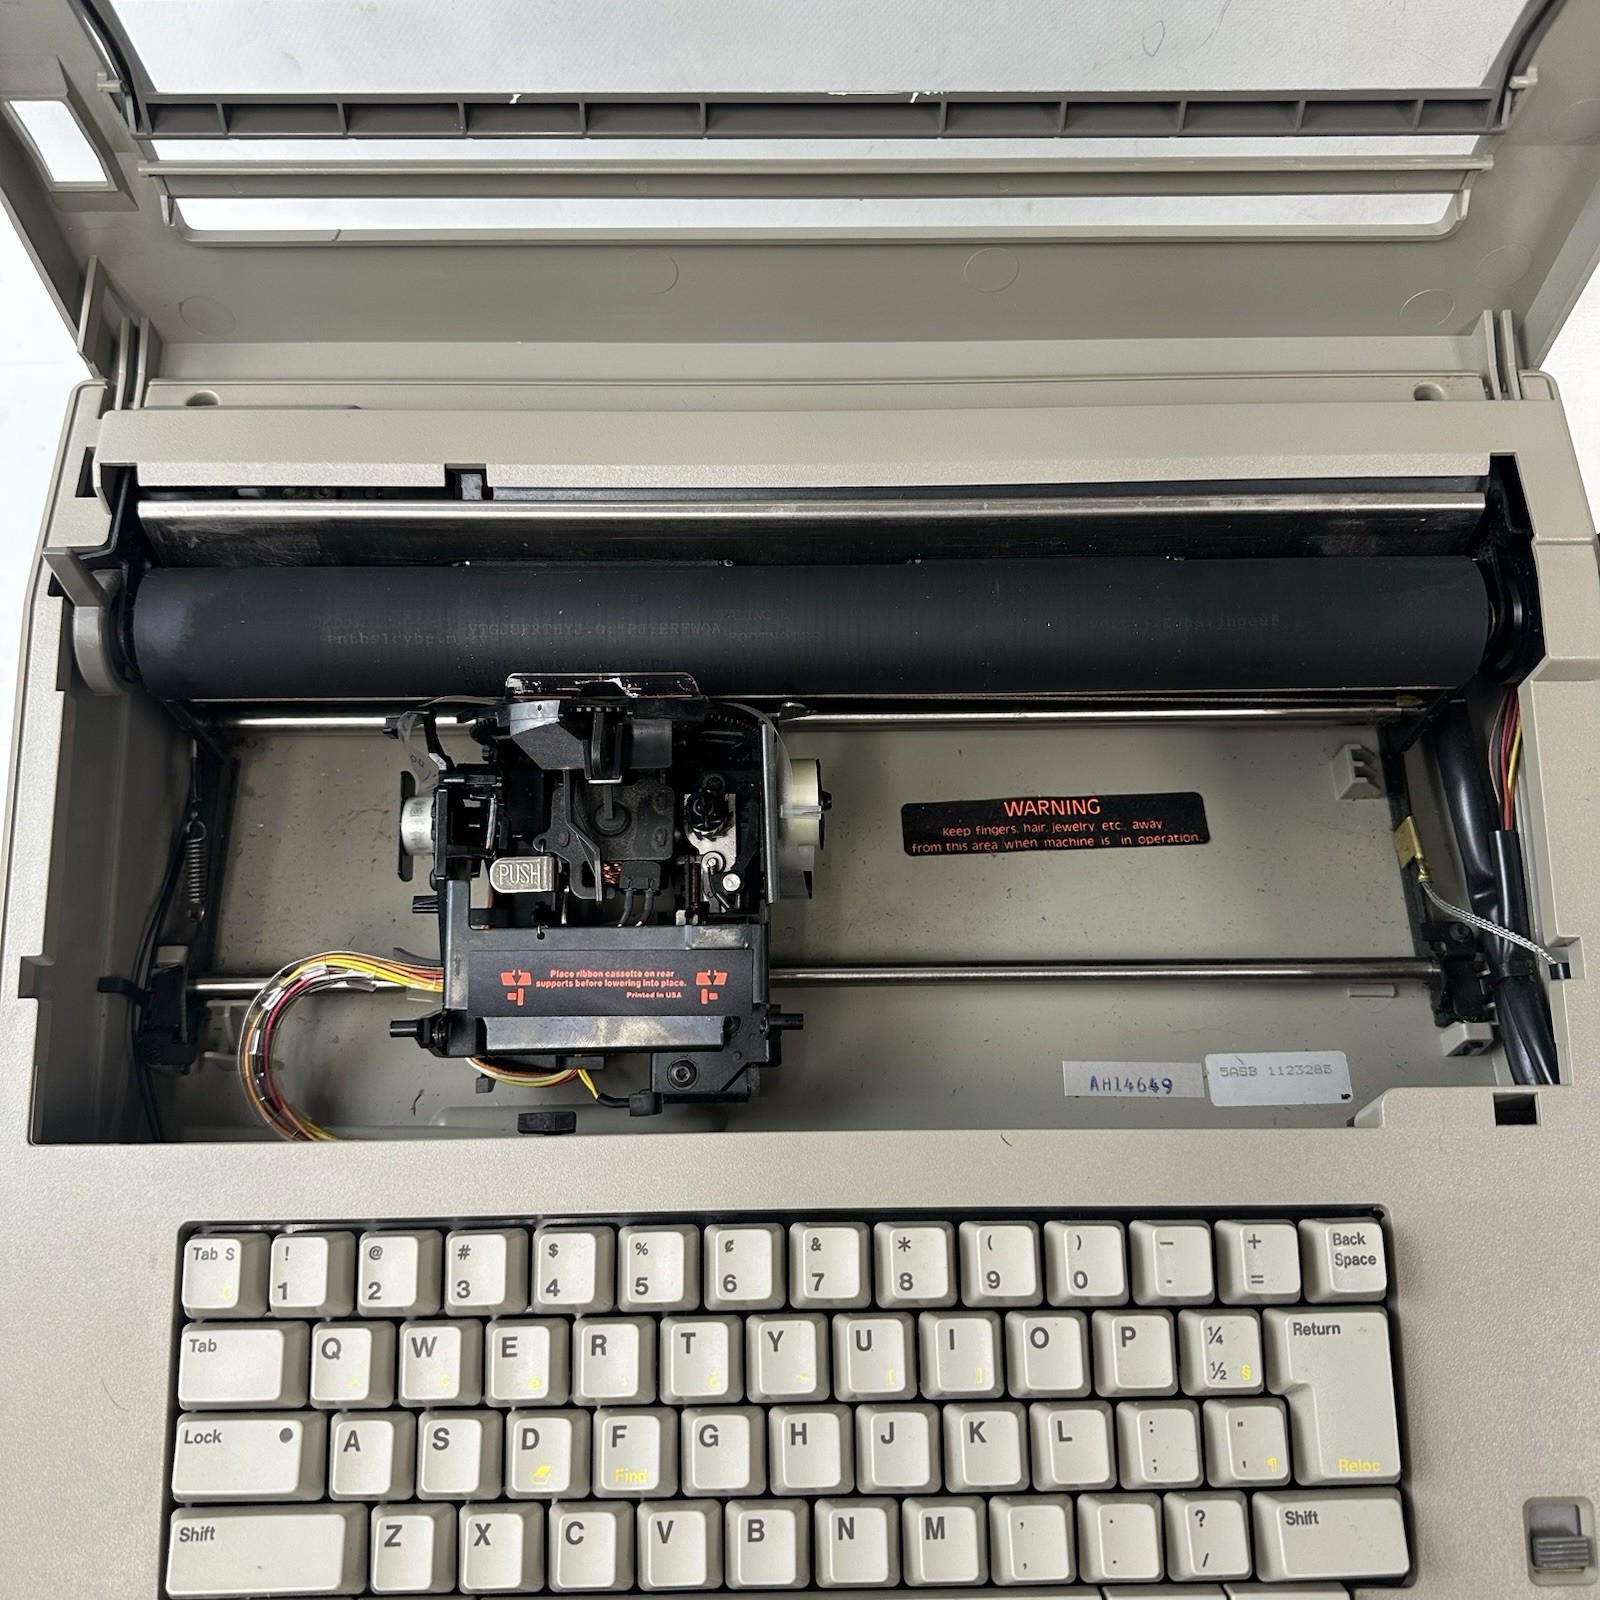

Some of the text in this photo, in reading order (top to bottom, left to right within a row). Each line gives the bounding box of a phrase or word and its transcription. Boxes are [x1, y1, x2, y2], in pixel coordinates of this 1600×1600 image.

[1003, 799, 1101, 817] WARNING
[942, 827, 971, 837] Keep
[1132, 819, 1163, 830] away
[911, 843, 942, 853] from
[945, 842, 969, 852] this
[971, 841, 999, 851] area
[1003, 839, 1038, 849] when
[1044, 837, 1095, 847] machine
[1101, 835, 1111, 846] is
[1120, 835, 1132, 845] in
[498, 863, 541, 886] PUSH
[550, 969, 675, 978] Place ribbon cassette on rear
[535, 979, 688, 989] supports before lowering into place.
[626, 991, 655, 999] Printed
[665, 991, 683, 999] USA
[635, 1242, 649, 1256] %
[810, 1237, 822, 1252] &
[987, 1234, 993, 1251] (
[1076, 1234, 1082, 1251] )
[1247, 1233, 1262, 1250] +
[1332, 1231, 1367, 1247] Back
[192, 1246, 219, 1261] Tab
[284, 1245, 290, 1262] !
[368, 1245, 383, 1261] @
[457, 1244, 472, 1261] #
[548, 1242, 559, 1259] $
[1334, 1252, 1377, 1269] Space
[456, 1279, 471, 1299] 3
[545, 1278, 561, 1297] 4
[634, 1276, 649, 1296] 5
[722, 1273, 738, 1294] 6
[811, 1272, 825, 1292] 7
[899, 1272, 914, 1292] 8
[986, 1270, 1001, 1290] 9
[1250, 1274, 1265, 1284] =
[277, 1282, 288, 1301] 1
[367, 1281, 382, 1301] 2
[1120, 1325, 1137, 1348] P
[1292, 1321, 1341, 1336] Return
[188, 1338, 218, 1353] Tab
[320, 1337, 342, 1360] Q
[410, 1336, 438, 1359] W
[501, 1336, 518, 1359] E
[590, 1334, 608, 1357] R
[680, 1332, 697, 1355] T
[767, 1330, 785, 1353] Y
[855, 1329, 873, 1352] U
[948, 1328, 955, 1351] I
[183, 1428, 222, 1445] Lock
[342, 1429, 361, 1453] A
[432, 1427, 450, 1451] S
[521, 1427, 540, 1451] D
[611, 1425, 628, 1448] F
[698, 1423, 719, 1448] G
[790, 1422, 808, 1446] H
[880, 1421, 895, 1445] J
[969, 1420, 987, 1444] K
[1057, 1420, 1073, 1443] L
[1337, 1457, 1380, 1472] Reloc
[613, 1467, 648, 1483] Find
[1194, 1509, 1206, 1528] ?
[1284, 1510, 1320, 1526] Shift
[178, 1525, 216, 1543] Shift
[383, 1524, 403, 1548] Z
[473, 1522, 492, 1547] X
[565, 1520, 585, 1546] C
[656, 1520, 674, 1544] V
[747, 1518, 765, 1543] B
[837, 1516, 855, 1541] N
[924, 1516, 946, 1541] M
[1202, 1552, 1210, 1568] /
